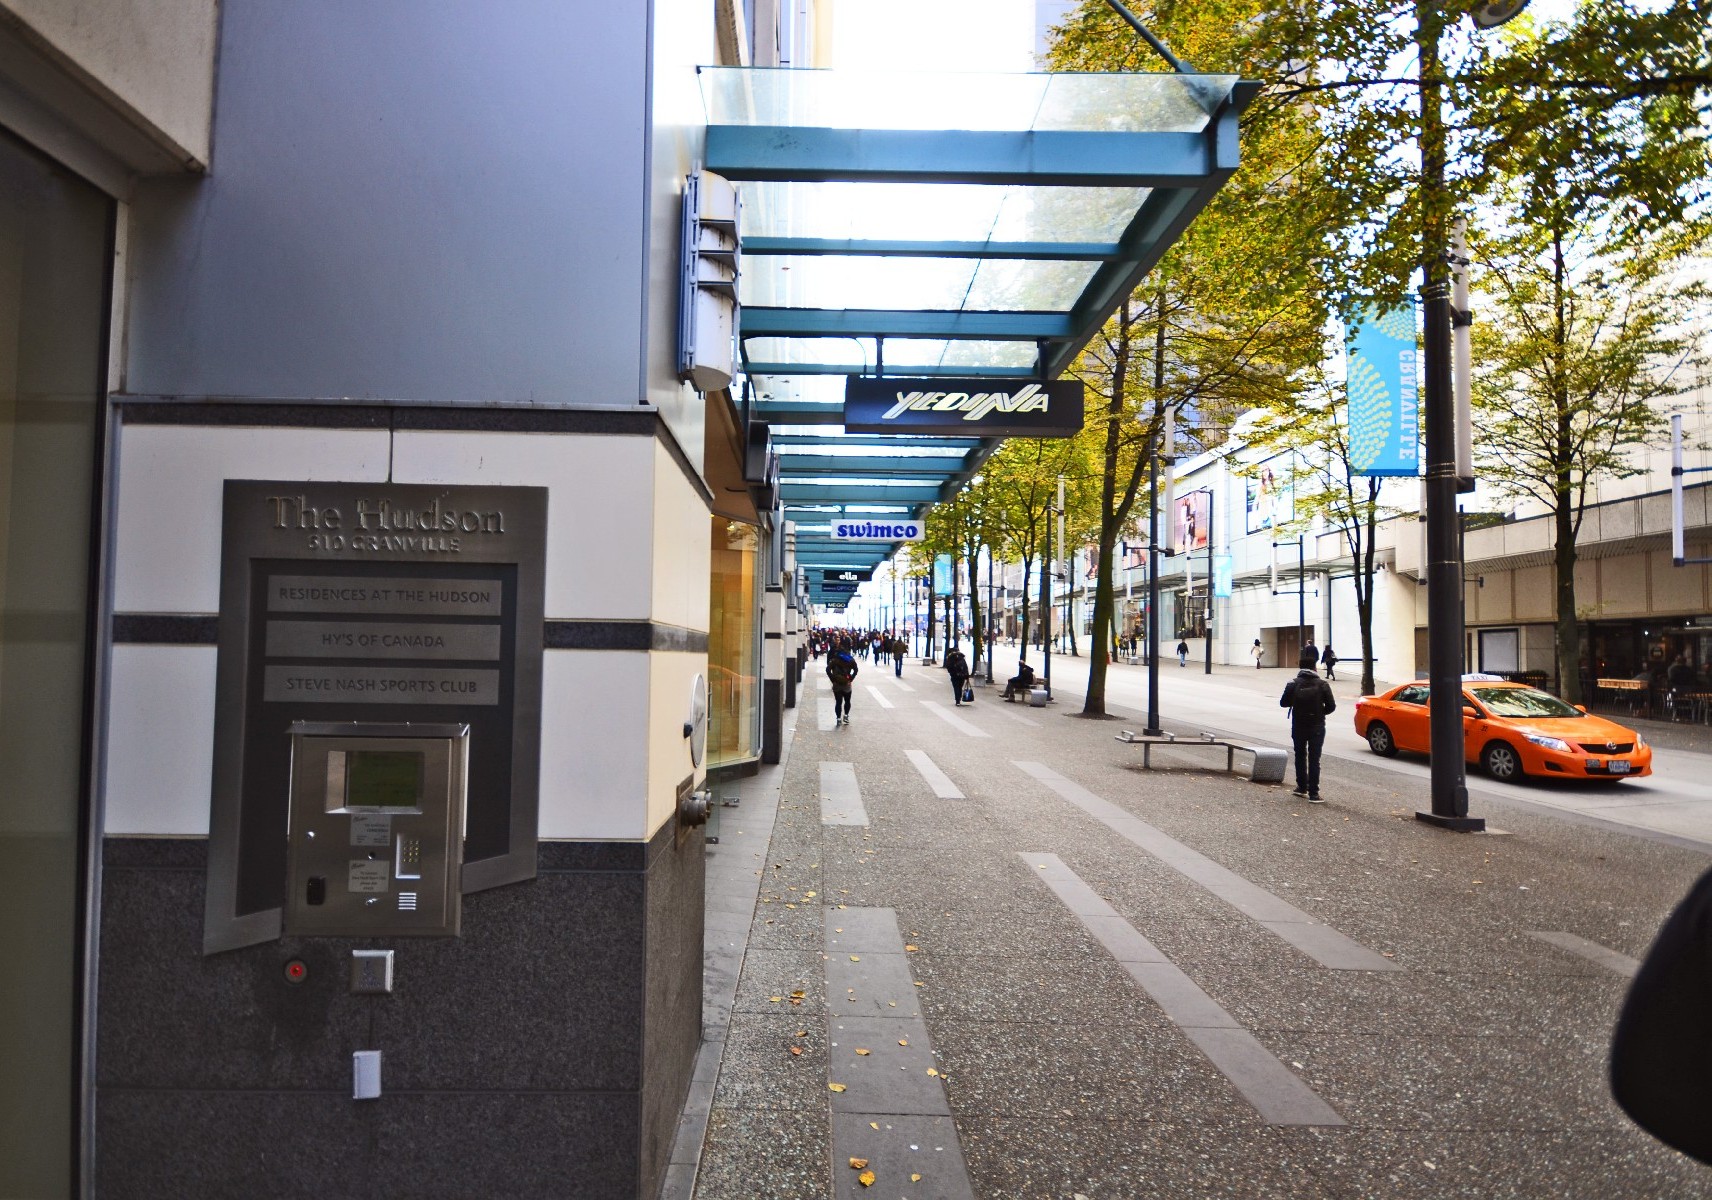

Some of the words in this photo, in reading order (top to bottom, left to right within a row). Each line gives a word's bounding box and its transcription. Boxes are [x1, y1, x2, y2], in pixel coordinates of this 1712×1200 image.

[267, 494, 342, 530] The
[355, 497, 504, 534] Hudson
[837, 521, 918, 538] swimco
[352, 535, 460, 552] GRANVILLE
[839, 571, 857, 581] ella
[279, 587, 366, 601] RESIDENCES
[372, 589, 391, 601] AT
[395, 590, 425, 602] THE
[429, 590, 490, 603] HUDSON
[322, 633, 354, 646] HY'S
[358, 634, 379, 646] OF
[382, 635, 444, 648] CANADA
[286, 678, 330, 691] STEVE
[336, 679, 375, 691] NASH
[379, 680, 435, 693] SPORTS
[440, 680, 477, 693] CLUB
